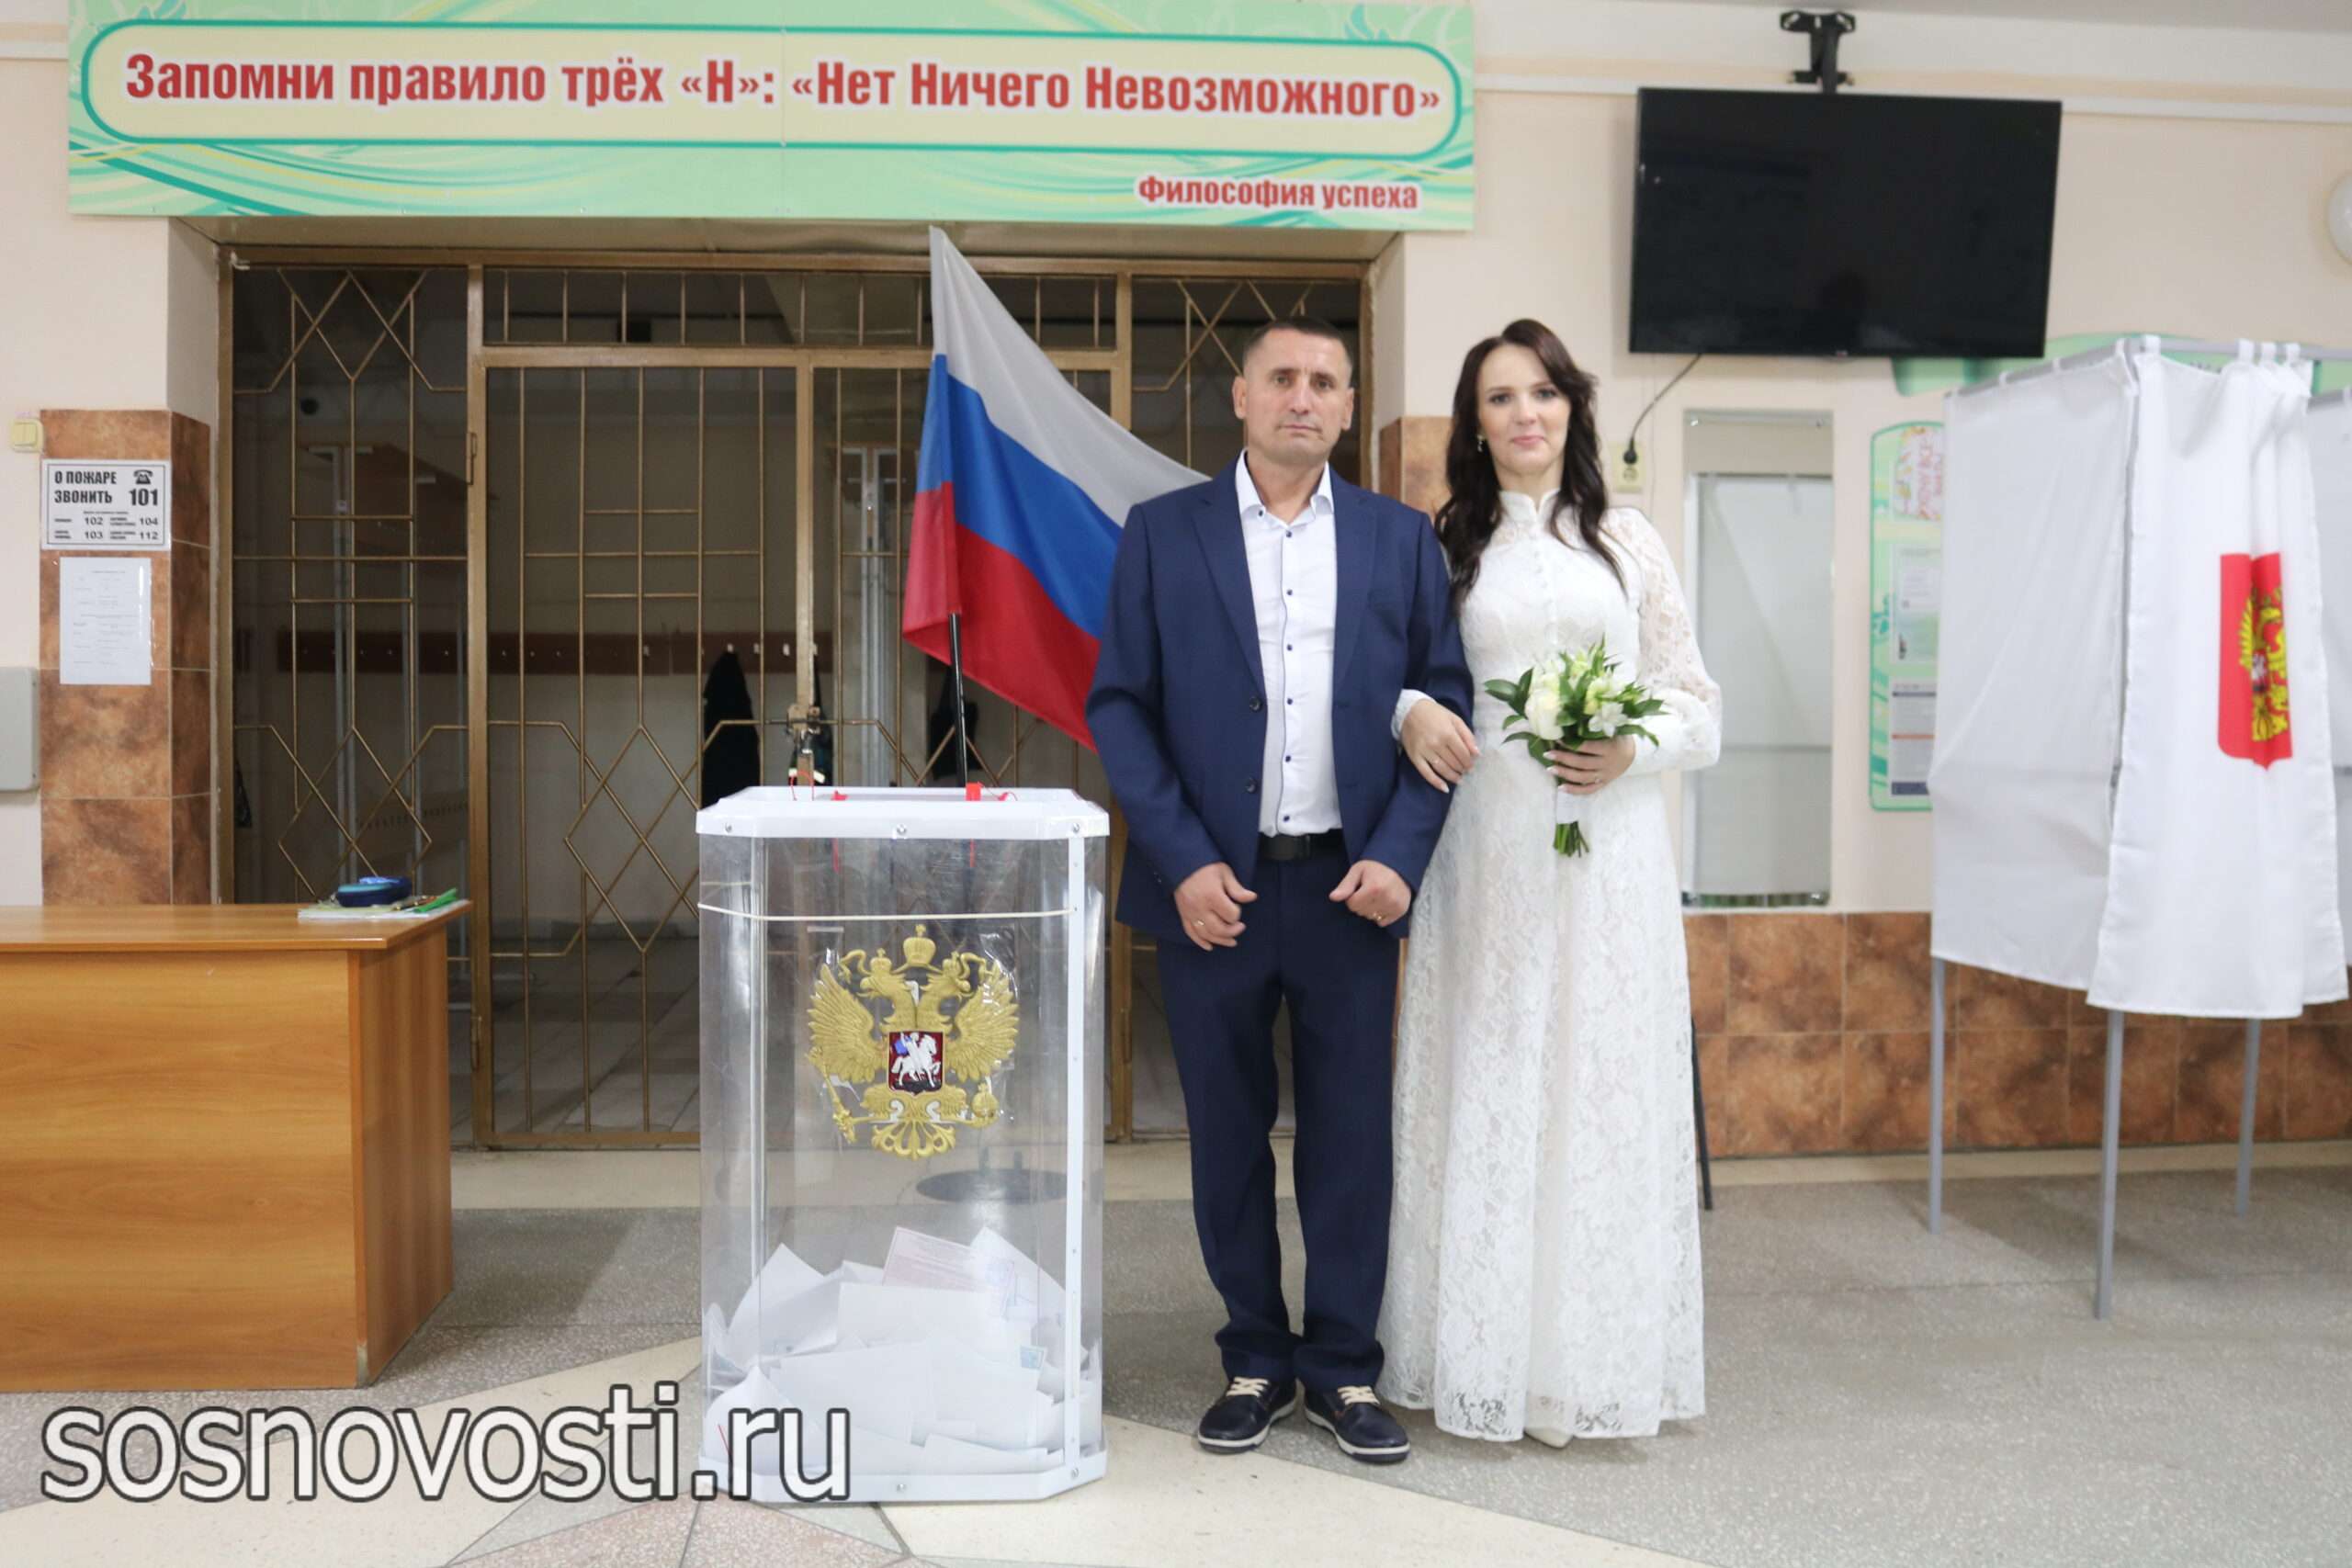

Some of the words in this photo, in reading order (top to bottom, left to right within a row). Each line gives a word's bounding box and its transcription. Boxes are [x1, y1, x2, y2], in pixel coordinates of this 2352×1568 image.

[125, 53, 334, 101] Запомни
[350, 62, 546, 107] правило
[560, 56, 663, 107] трёх
[680, 60, 775, 104] «Н»:
[791, 61, 896, 106] «Нет
[911, 63, 1070, 109] Ничего
[1084, 66, 1441, 117] Невозможного»
[1138, 175, 1315, 209] Философия
[1322, 183, 1419, 209] успеха
[55, 470, 62, 484] О
[66, 470, 117, 484] ПОЖАРЕ
[54, 491, 112, 503] ЗВОНИТЬ
[130, 489, 158, 505] 101
[85, 517, 103, 526] 102
[140, 517, 158, 526] 104
[85, 531, 103, 540] 103
[140, 531, 158, 540] 112
